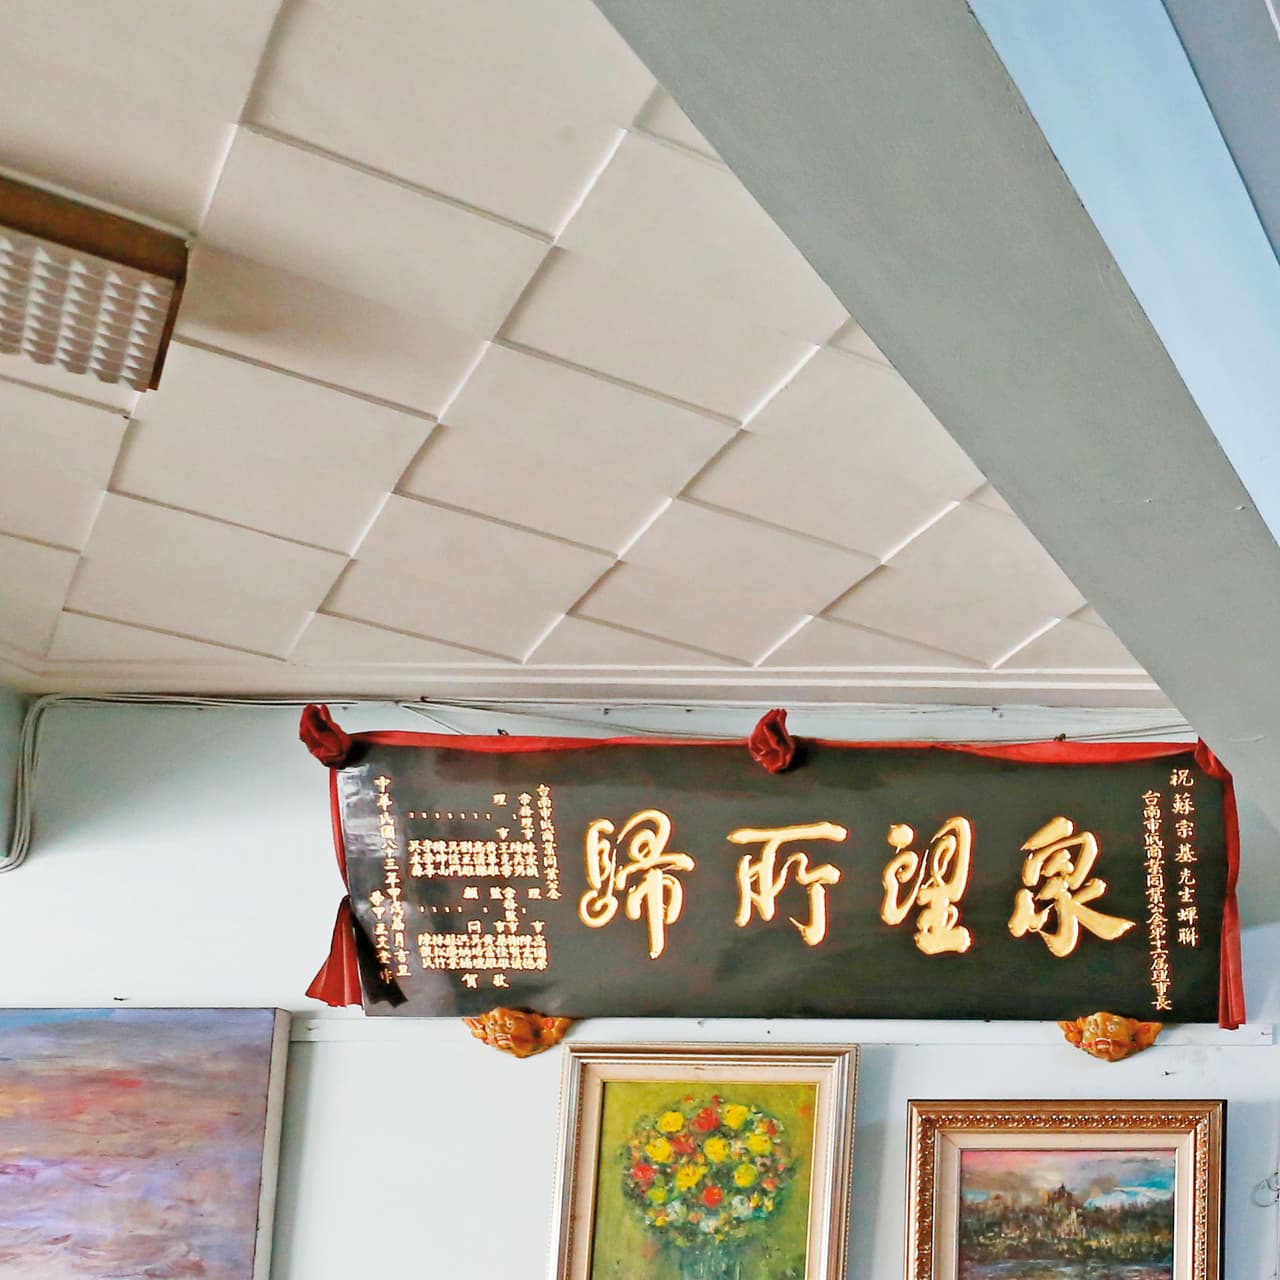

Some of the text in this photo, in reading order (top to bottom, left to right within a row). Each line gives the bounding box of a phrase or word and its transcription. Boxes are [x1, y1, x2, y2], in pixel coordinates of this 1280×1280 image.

[1169, 768, 1199, 947] 祝蘇宗基先生蟬聯
